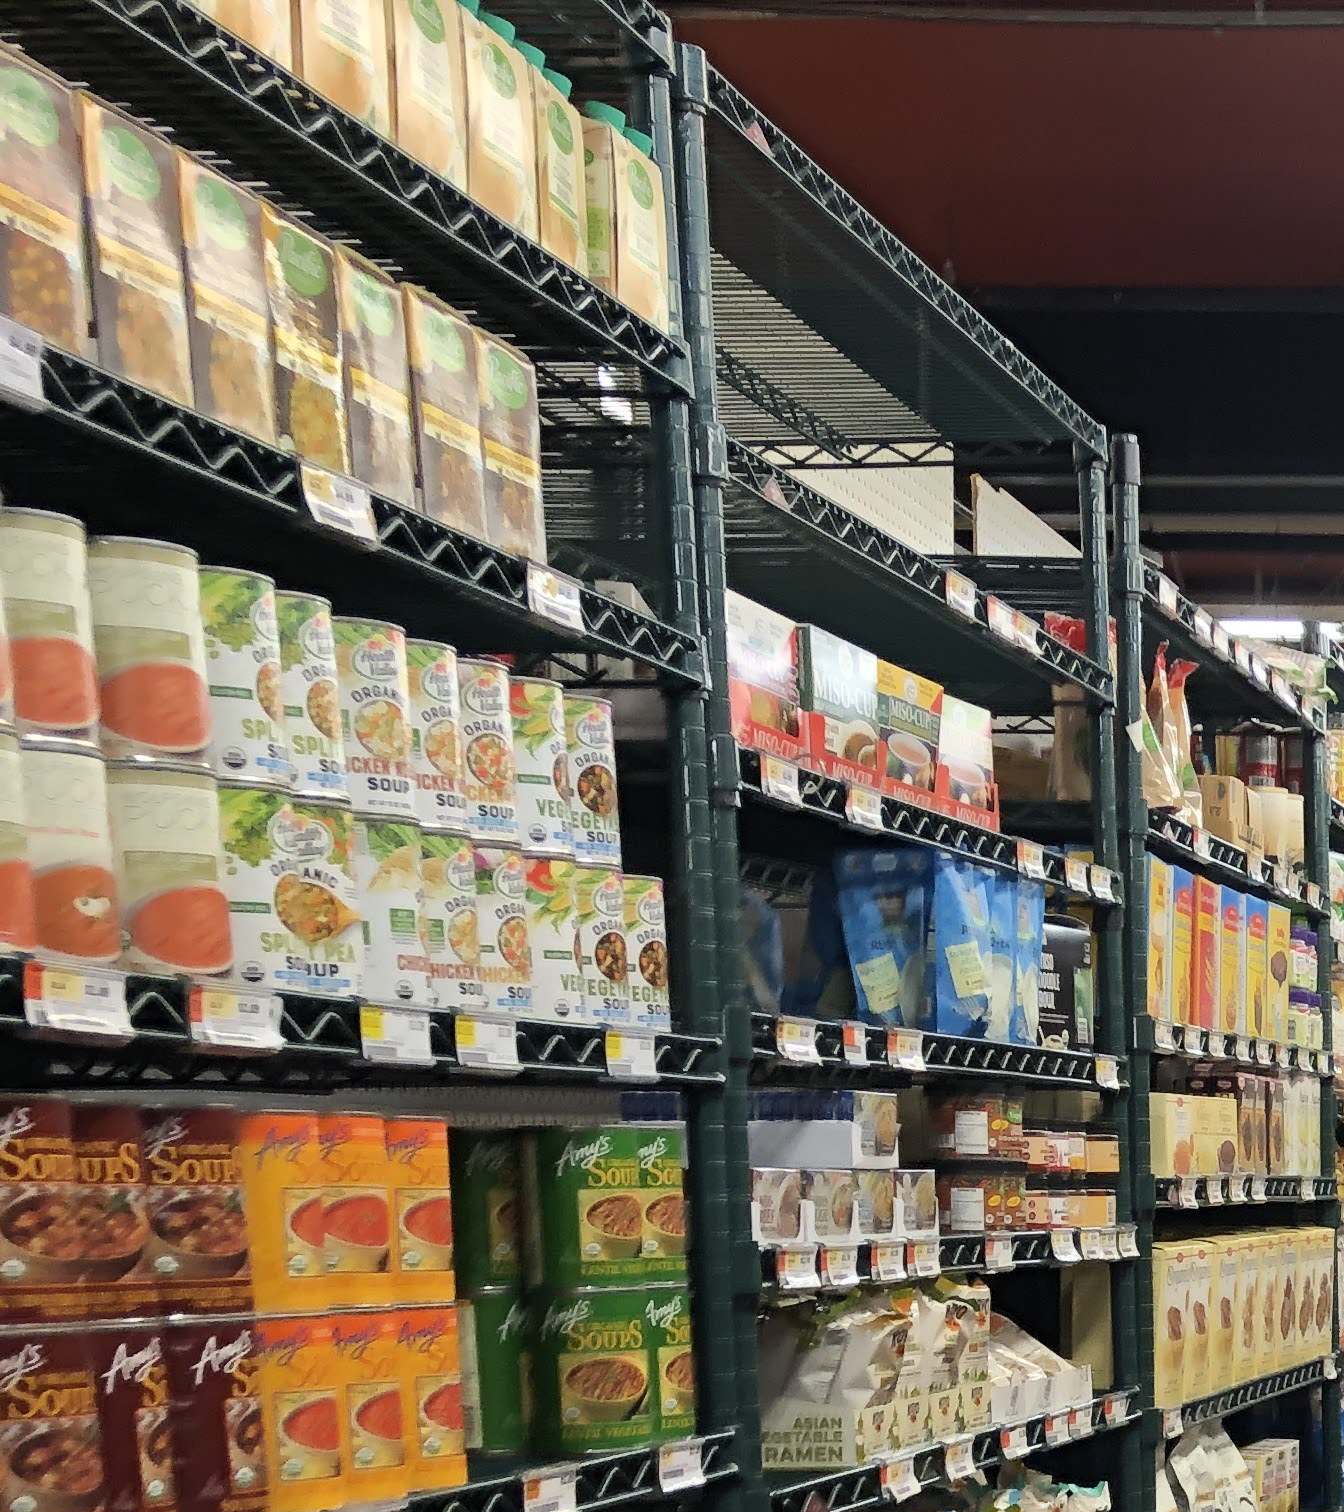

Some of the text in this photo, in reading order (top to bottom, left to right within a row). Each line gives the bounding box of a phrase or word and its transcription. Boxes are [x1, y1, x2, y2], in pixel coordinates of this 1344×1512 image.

[351, 685, 404, 705] ORGAN
[421, 706, 454, 722] ORGA
[889, 695, 932, 730] MISO-CUP
[464, 720, 507, 736] ORGAN
[574, 751, 610, 767] ORGAN
[367, 777, 410, 794] SOUP
[435, 793, 467, 808] SOU
[459, 982, 484, 996] SOU
[508, 986, 532, 998] SOU
[603, 997, 630, 1010] SOU
[647, 1003, 670, 1017] SOU
[556, 1135, 613, 1177] Amy's
[637, 1136, 669, 1168] my's
[793, 1417, 843, 1430] ASIAN
[763, 1446, 843, 1463] RAMEN
